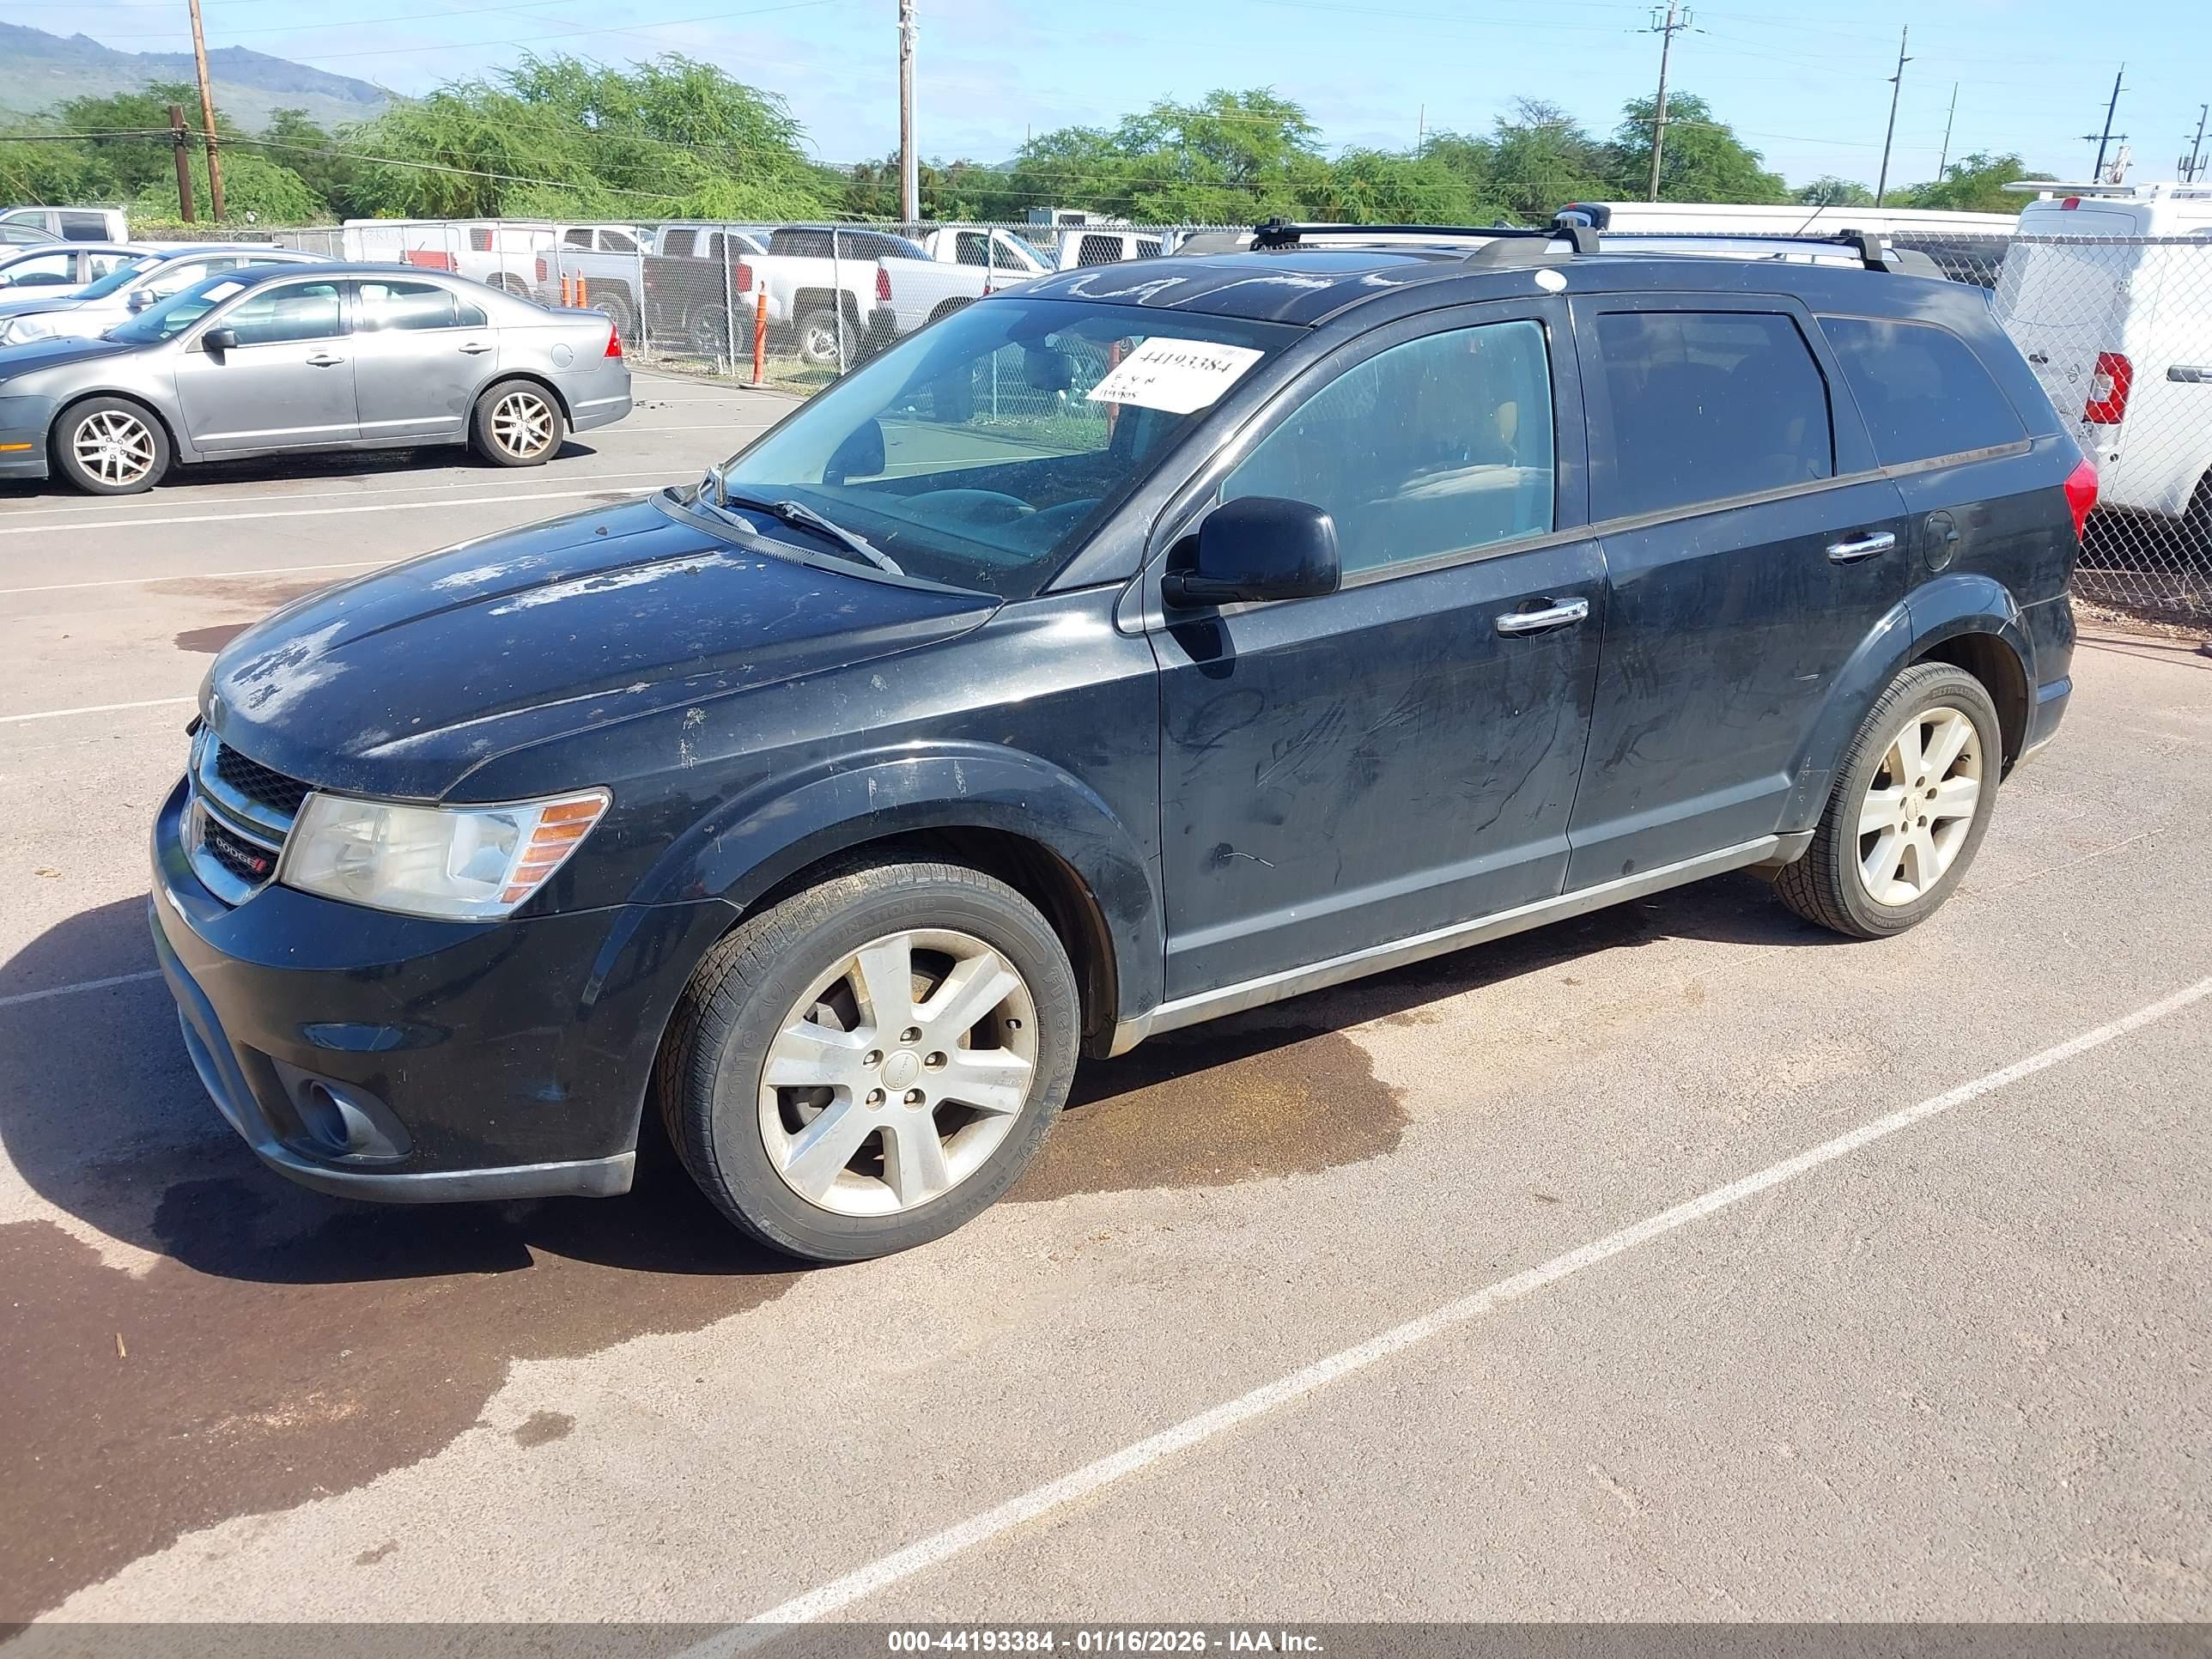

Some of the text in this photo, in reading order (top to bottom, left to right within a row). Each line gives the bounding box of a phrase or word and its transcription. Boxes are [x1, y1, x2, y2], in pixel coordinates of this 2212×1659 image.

[1140, 351, 1233, 373] 44193384
[216, 837, 256, 868] DODGE
[1041, 967, 1071, 1115] Firestone
